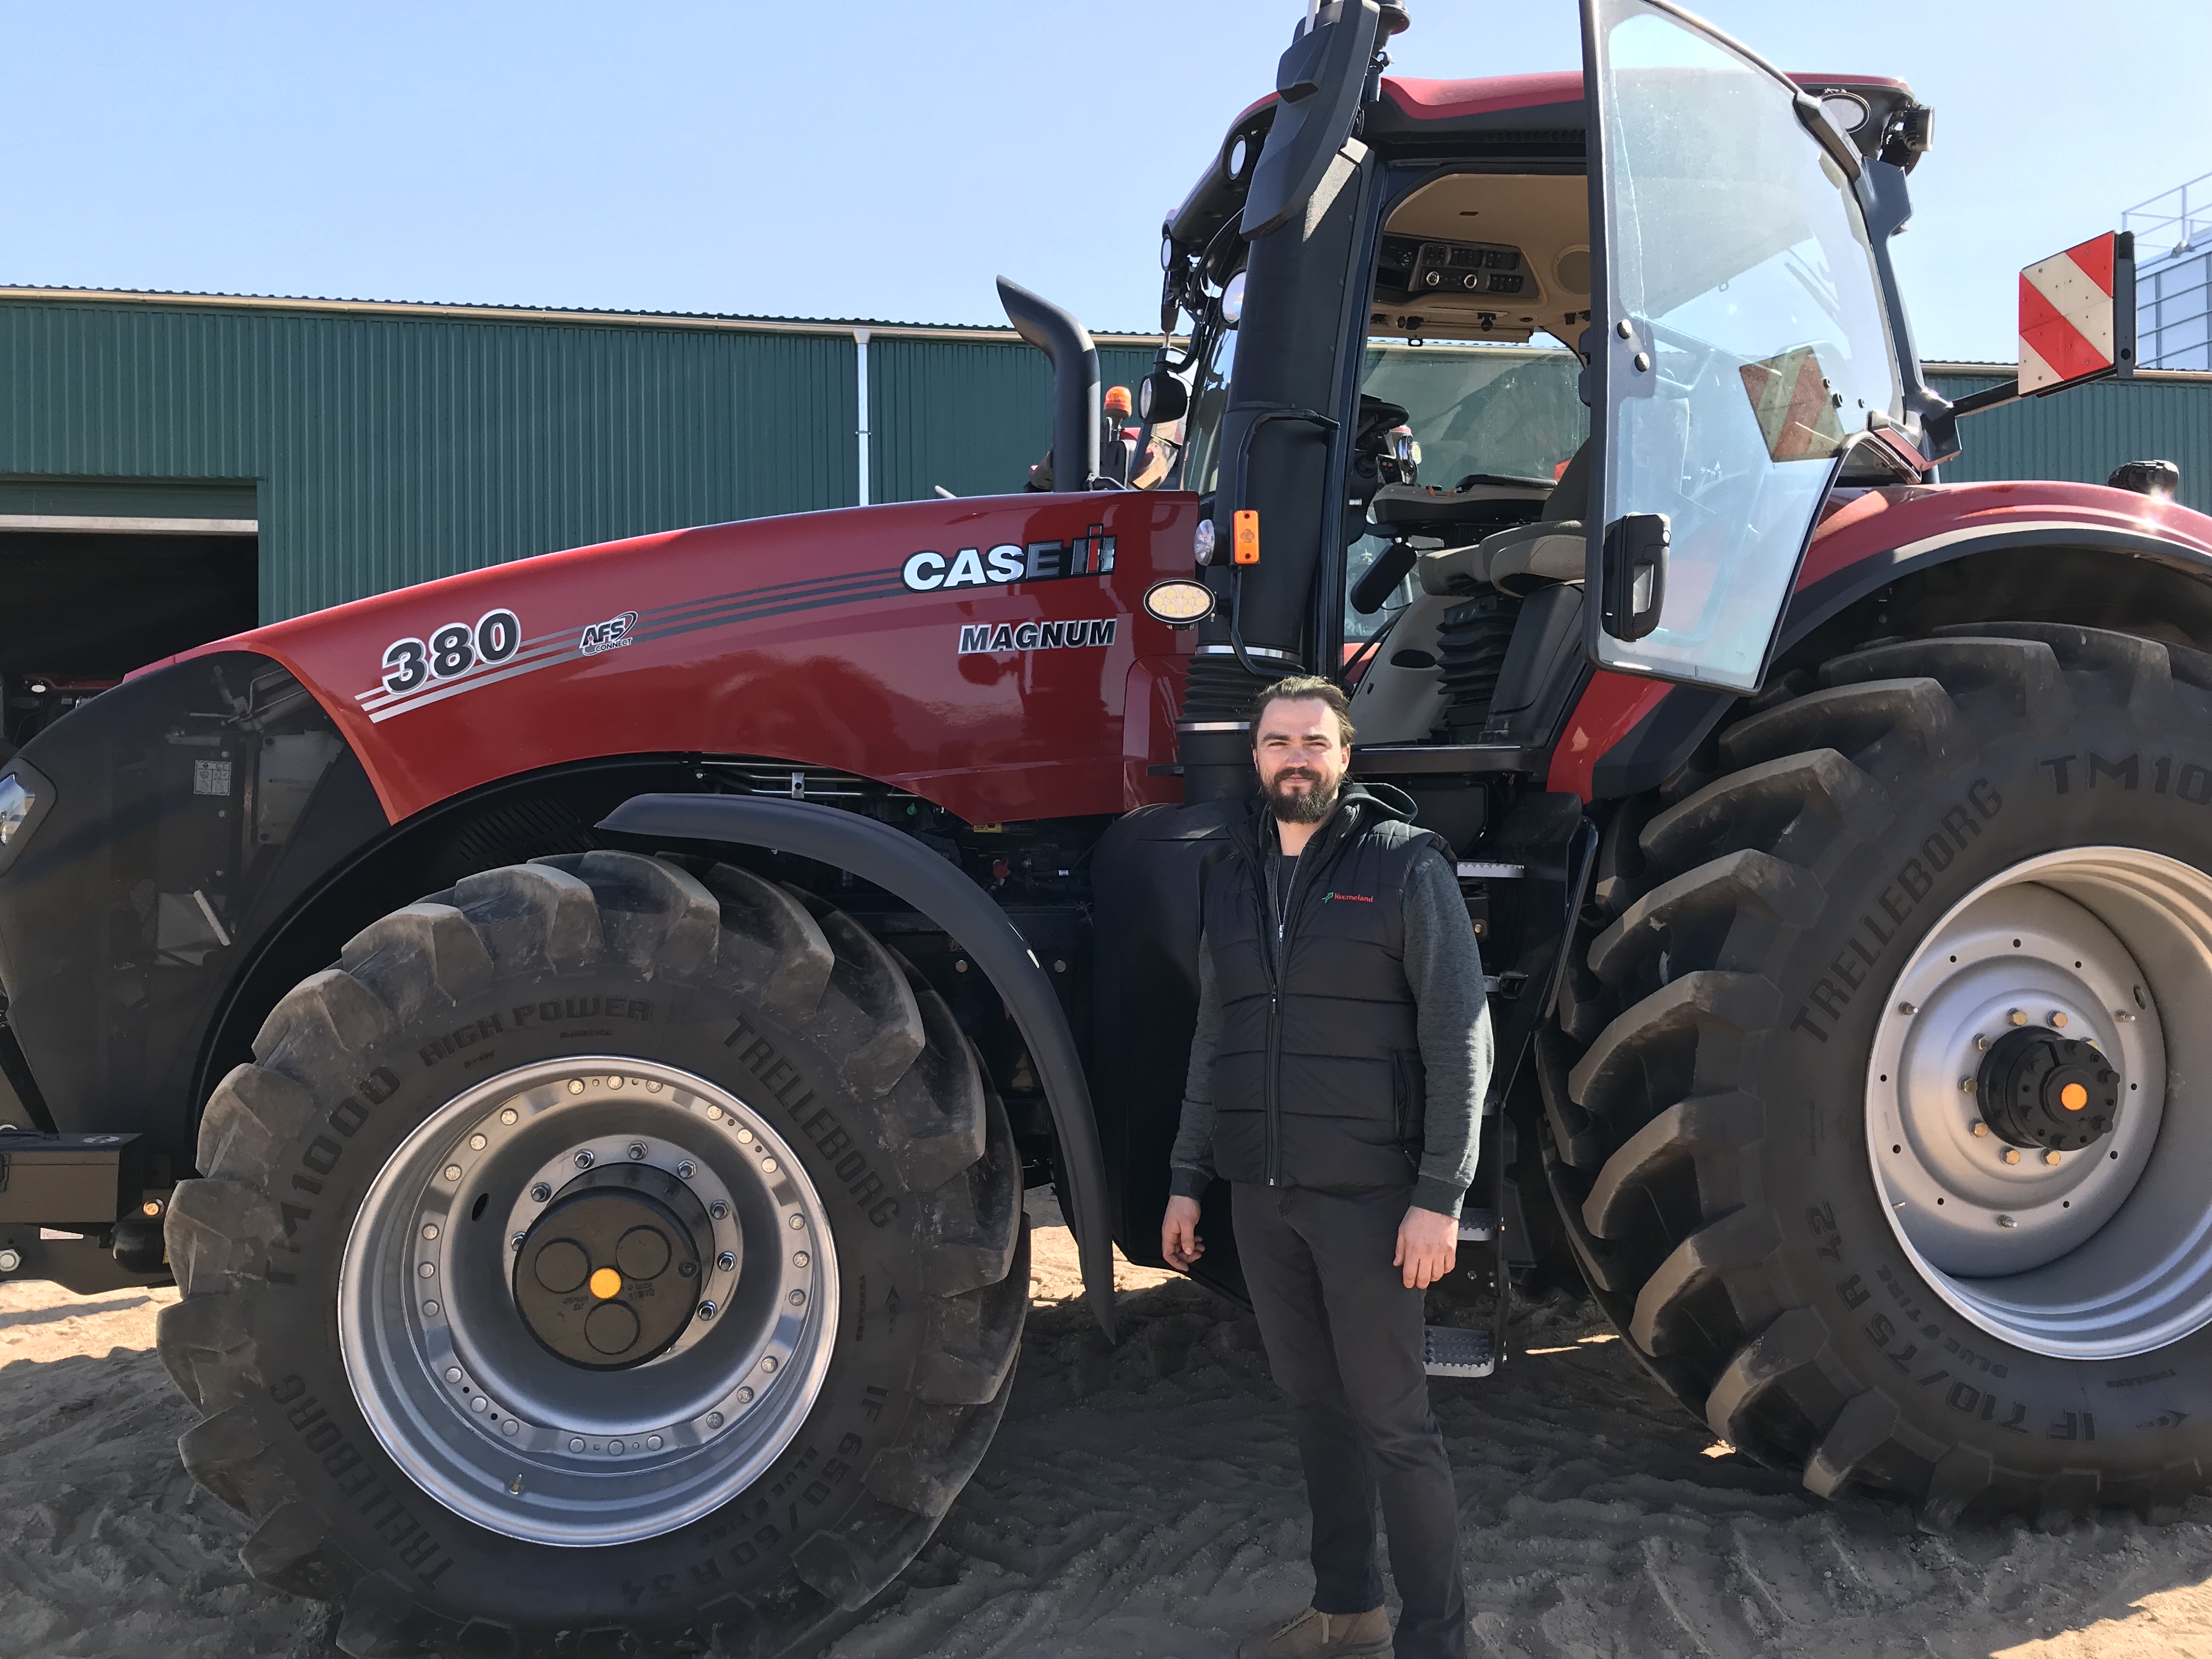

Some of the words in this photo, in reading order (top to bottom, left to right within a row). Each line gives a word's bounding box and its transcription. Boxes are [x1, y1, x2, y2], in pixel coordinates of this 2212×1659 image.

[903, 541, 1063, 591] CASE
[382, 608, 521, 695] 380
[580, 617, 626, 648] AFS
[595, 636, 633, 652] CONNECT
[958, 618, 1118, 654] MAGNUM
[1334, 893, 1374, 902] Kverneland
[1788, 777, 2004, 1045] TRELLEBORG
[417, 1012, 504, 1067] HIGH
[512, 996, 652, 1027] POWER
[723, 1014, 901, 1229] TRELLEBORG
[1805, 1200, 1842, 1263] 42
[1836, 1273, 1871, 1311] R
[1876, 1264, 1920, 1323] TIRE
[1863, 1314, 2029, 1435] 710/75
[1943, 1331, 2009, 1379] BLUE
[861, 1385, 890, 1423] IF
[2047, 1410, 2096, 1441] IF
[270, 1373, 455, 1592] TRELLEBORG
[771, 1445, 819, 1498] BLUE
[727, 1431, 863, 1566] 650/60
[698, 1511, 751, 1547] TIRE
[689, 1558, 724, 1585] R
